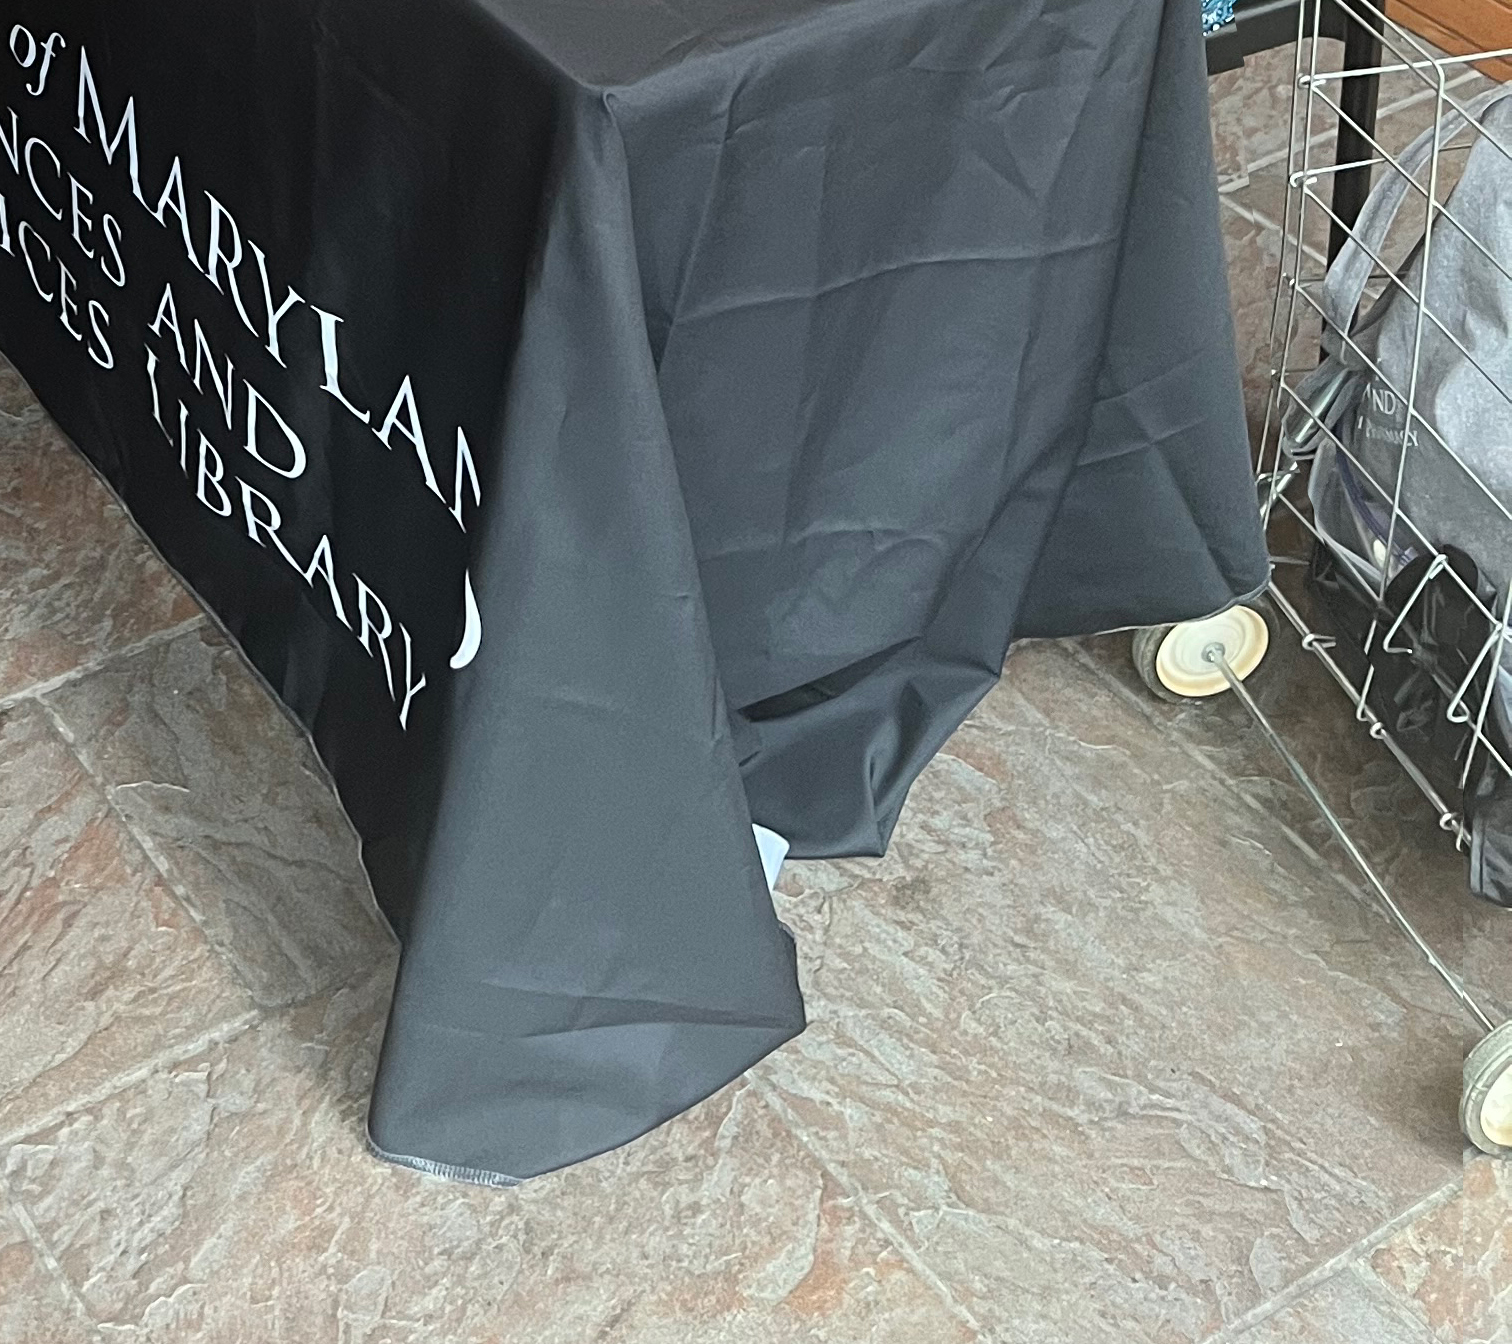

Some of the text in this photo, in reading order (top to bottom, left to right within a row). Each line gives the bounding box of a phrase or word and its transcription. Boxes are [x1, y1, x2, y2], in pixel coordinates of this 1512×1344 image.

[9, 23, 64, 97] of
[74, 46, 484, 536] MARYLAN
[147, 282, 307, 481] AND
[144, 344, 427, 731] LIBRARY
